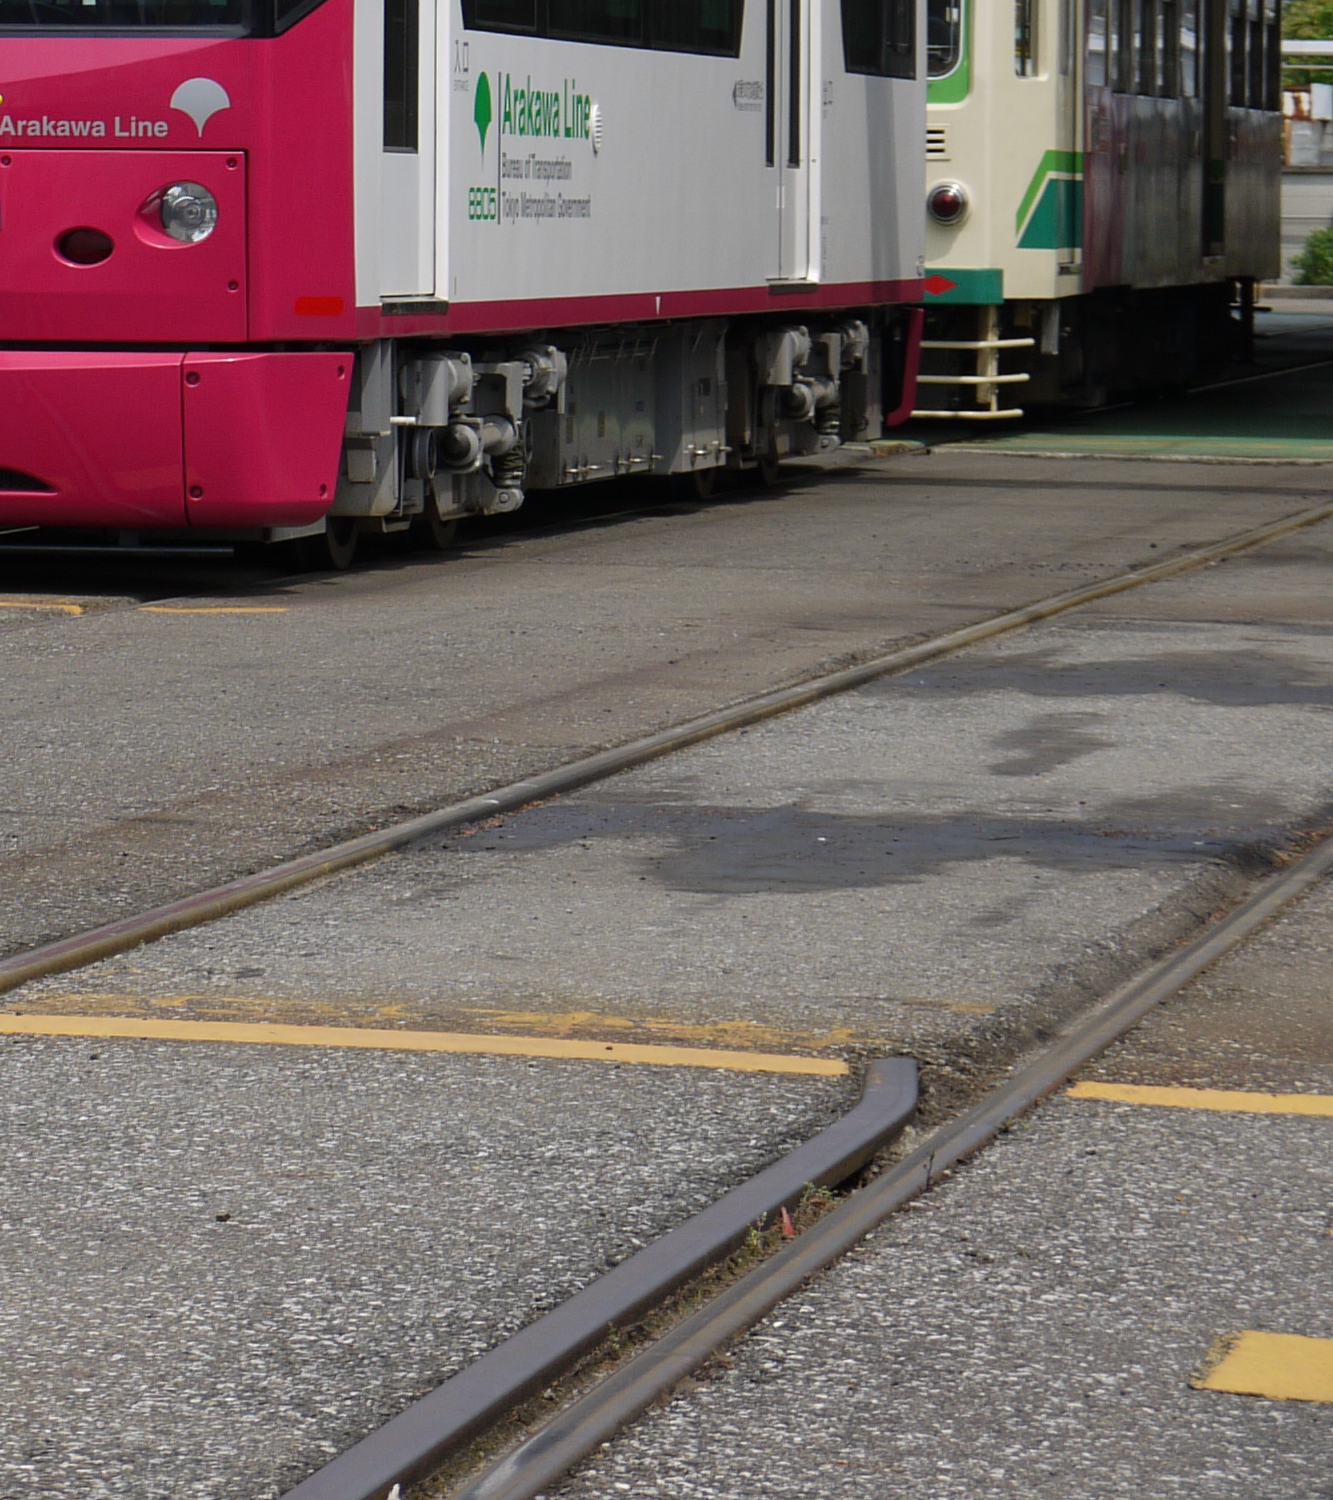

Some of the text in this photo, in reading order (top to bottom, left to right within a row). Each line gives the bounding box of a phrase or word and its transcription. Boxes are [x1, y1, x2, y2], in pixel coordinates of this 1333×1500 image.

[502, 73, 591, 140] Arakawa Line
[114, 116, 169, 137] Line
[468, 186, 497, 221] 8805
